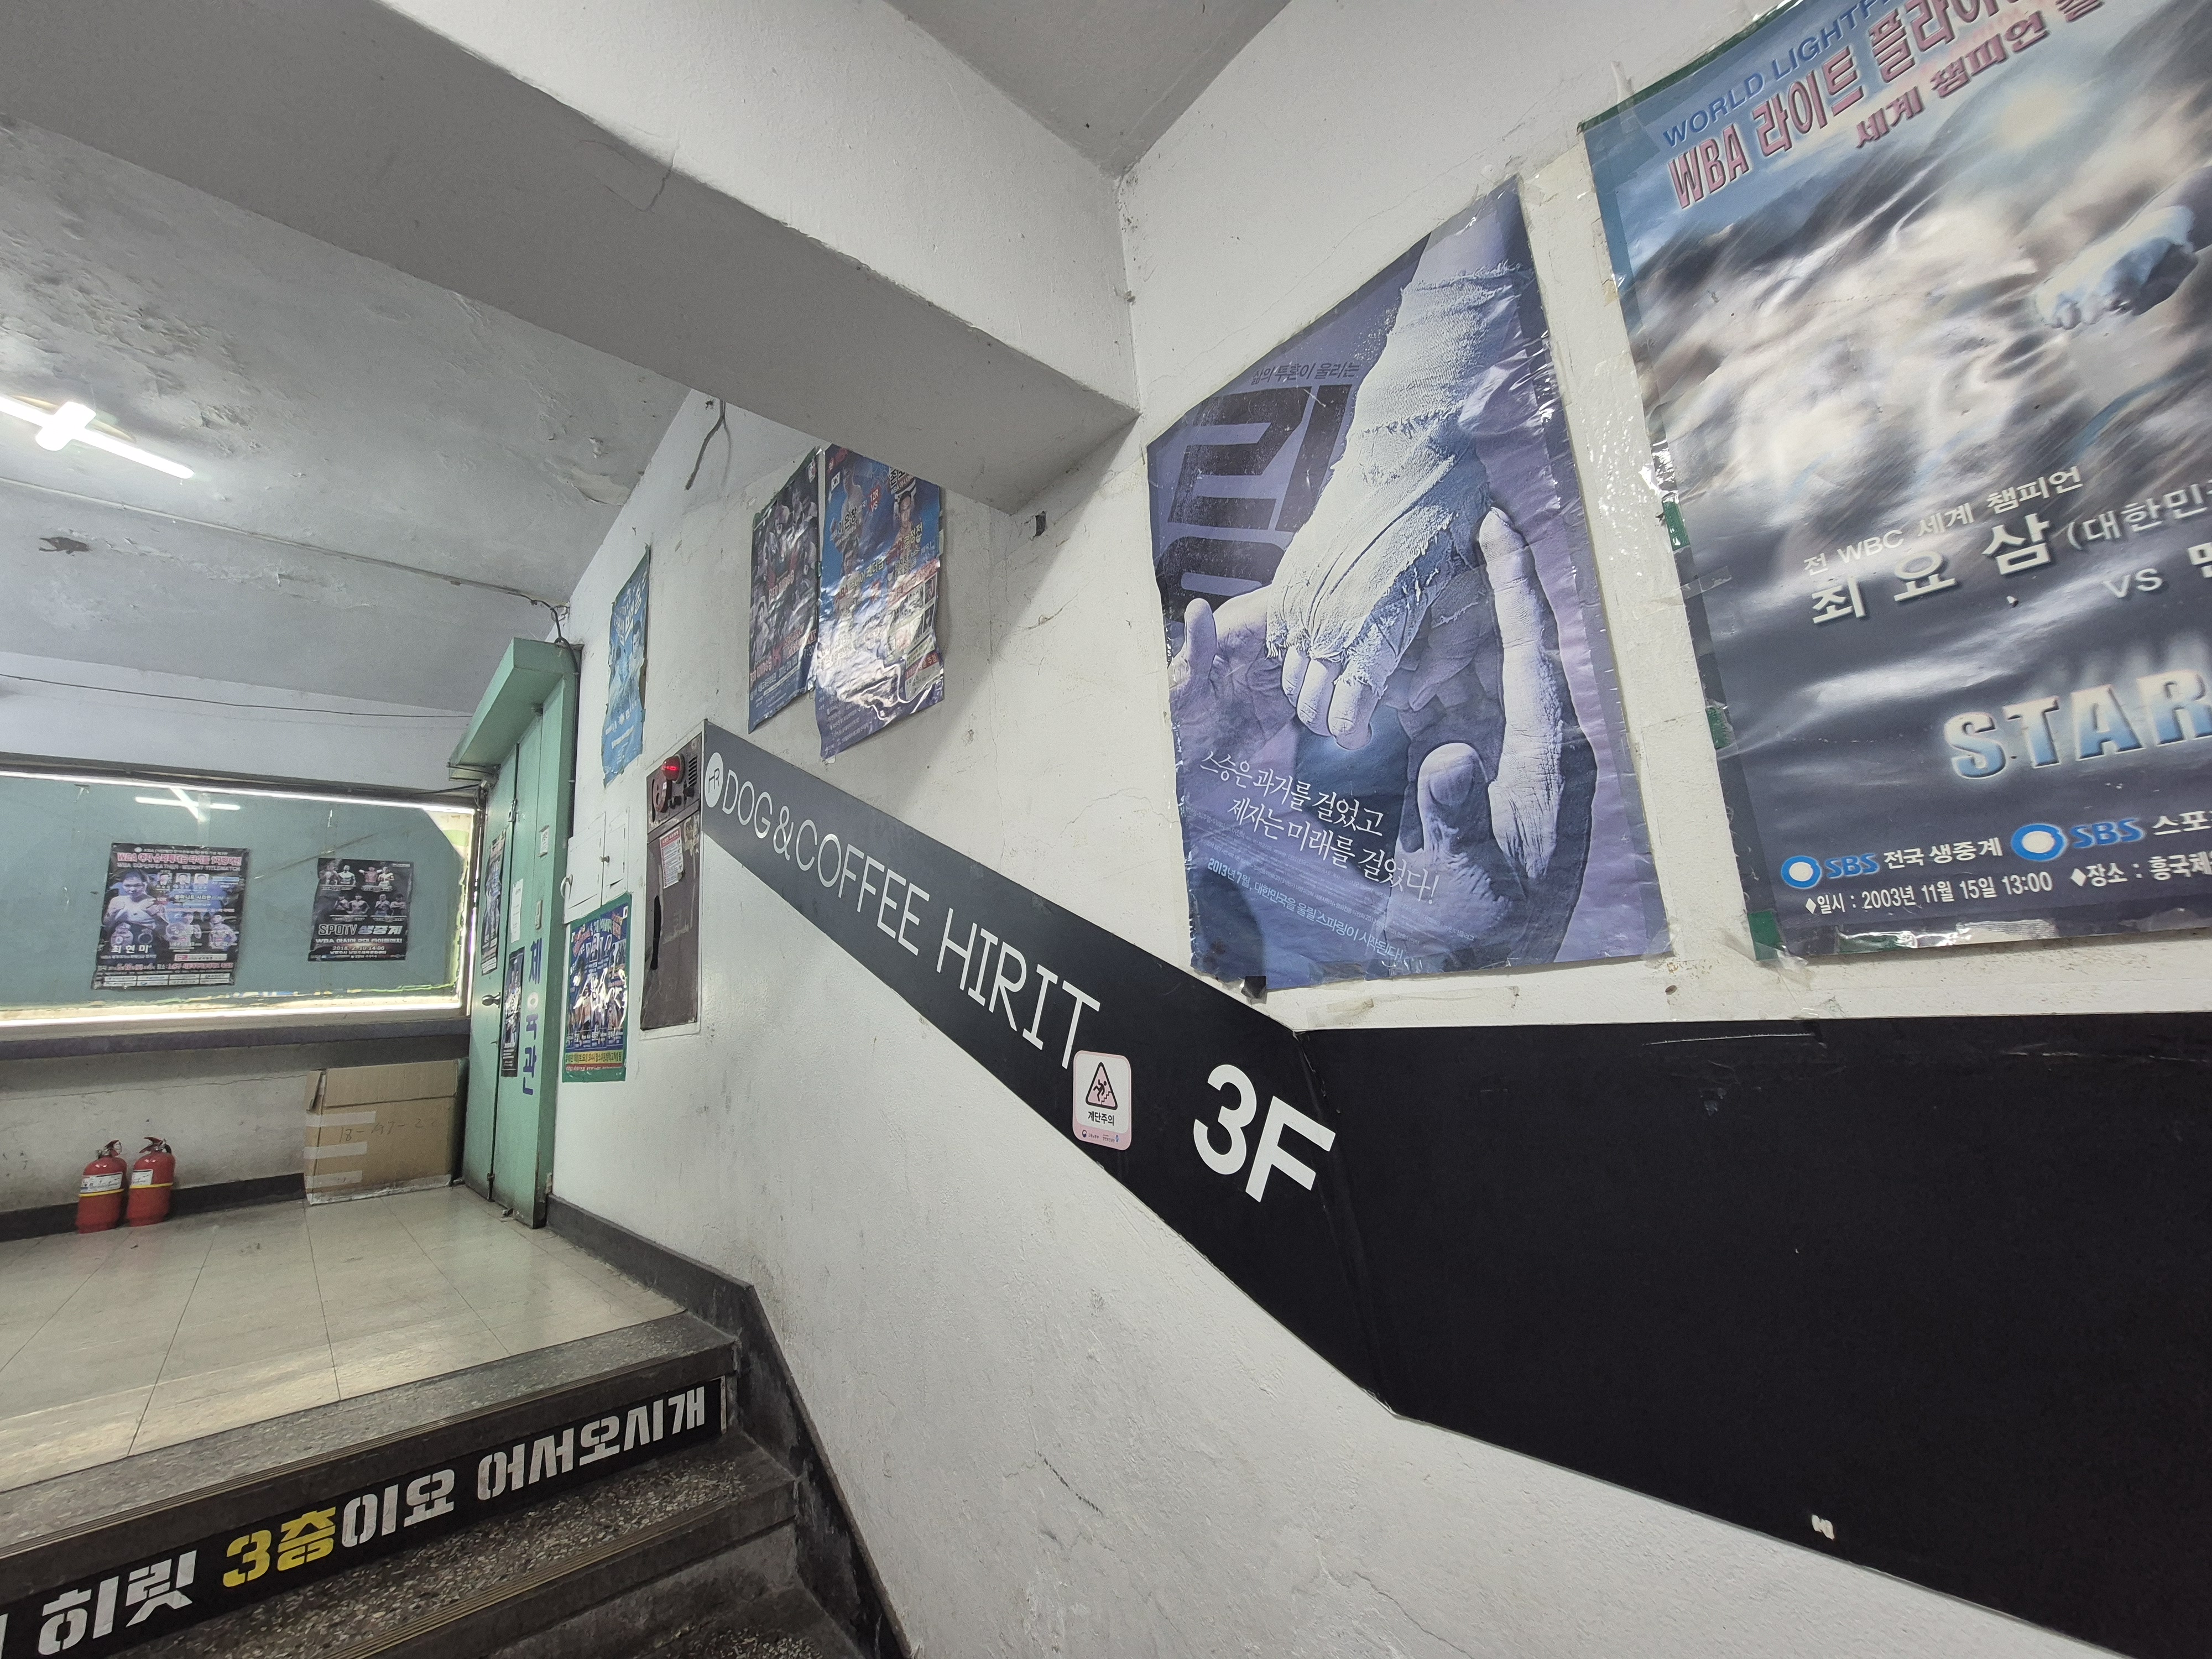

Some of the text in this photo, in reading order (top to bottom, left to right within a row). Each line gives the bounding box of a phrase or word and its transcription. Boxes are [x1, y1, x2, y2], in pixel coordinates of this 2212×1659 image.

[1662, 0, 1892, 148] WORLD LIGHTF
[1667, 0, 2021, 210] WBA 라이트 플라이
[1855, 10, 2051, 149] 세계 챔피언
[1314, 361, 1360, 380] 울리는
[1803, 466, 2084, 576] 전 WBC 세계 챔피언
[2067, 478, 2212, 550] (대한민
[1199, 750, 1384, 837] 스승은 과거를 걸었고
[1207, 858, 1237, 881] 2013년
[1235, 872, 1253, 891] 7월,
[1254, 881, 1296, 911] 대한민국을
[1297, 902, 1317, 922] 울릴
[1227, 797, 1285, 840] 제자는
[1288, 821, 1356, 869] 미래를
[1358, 847, 1439, 904] 걸었다!
[1816, 850, 2212, 915] 일시 2003년 11월 15일 13:00 장소 흥국체
[1827, 809, 2212, 879] SBS 전국 생중계 SBS 스포
[318, 924, 358, 936] SPOTV
[936, 907, 1100, 1070] HIRIT
[1088, 1110, 1114, 1126] 계단주의
[1193, 1064, 1336, 1202] 3F
[38, 1550, 197, 1655] 히릿
[476, 1385, 706, 1502] 어서오시개
